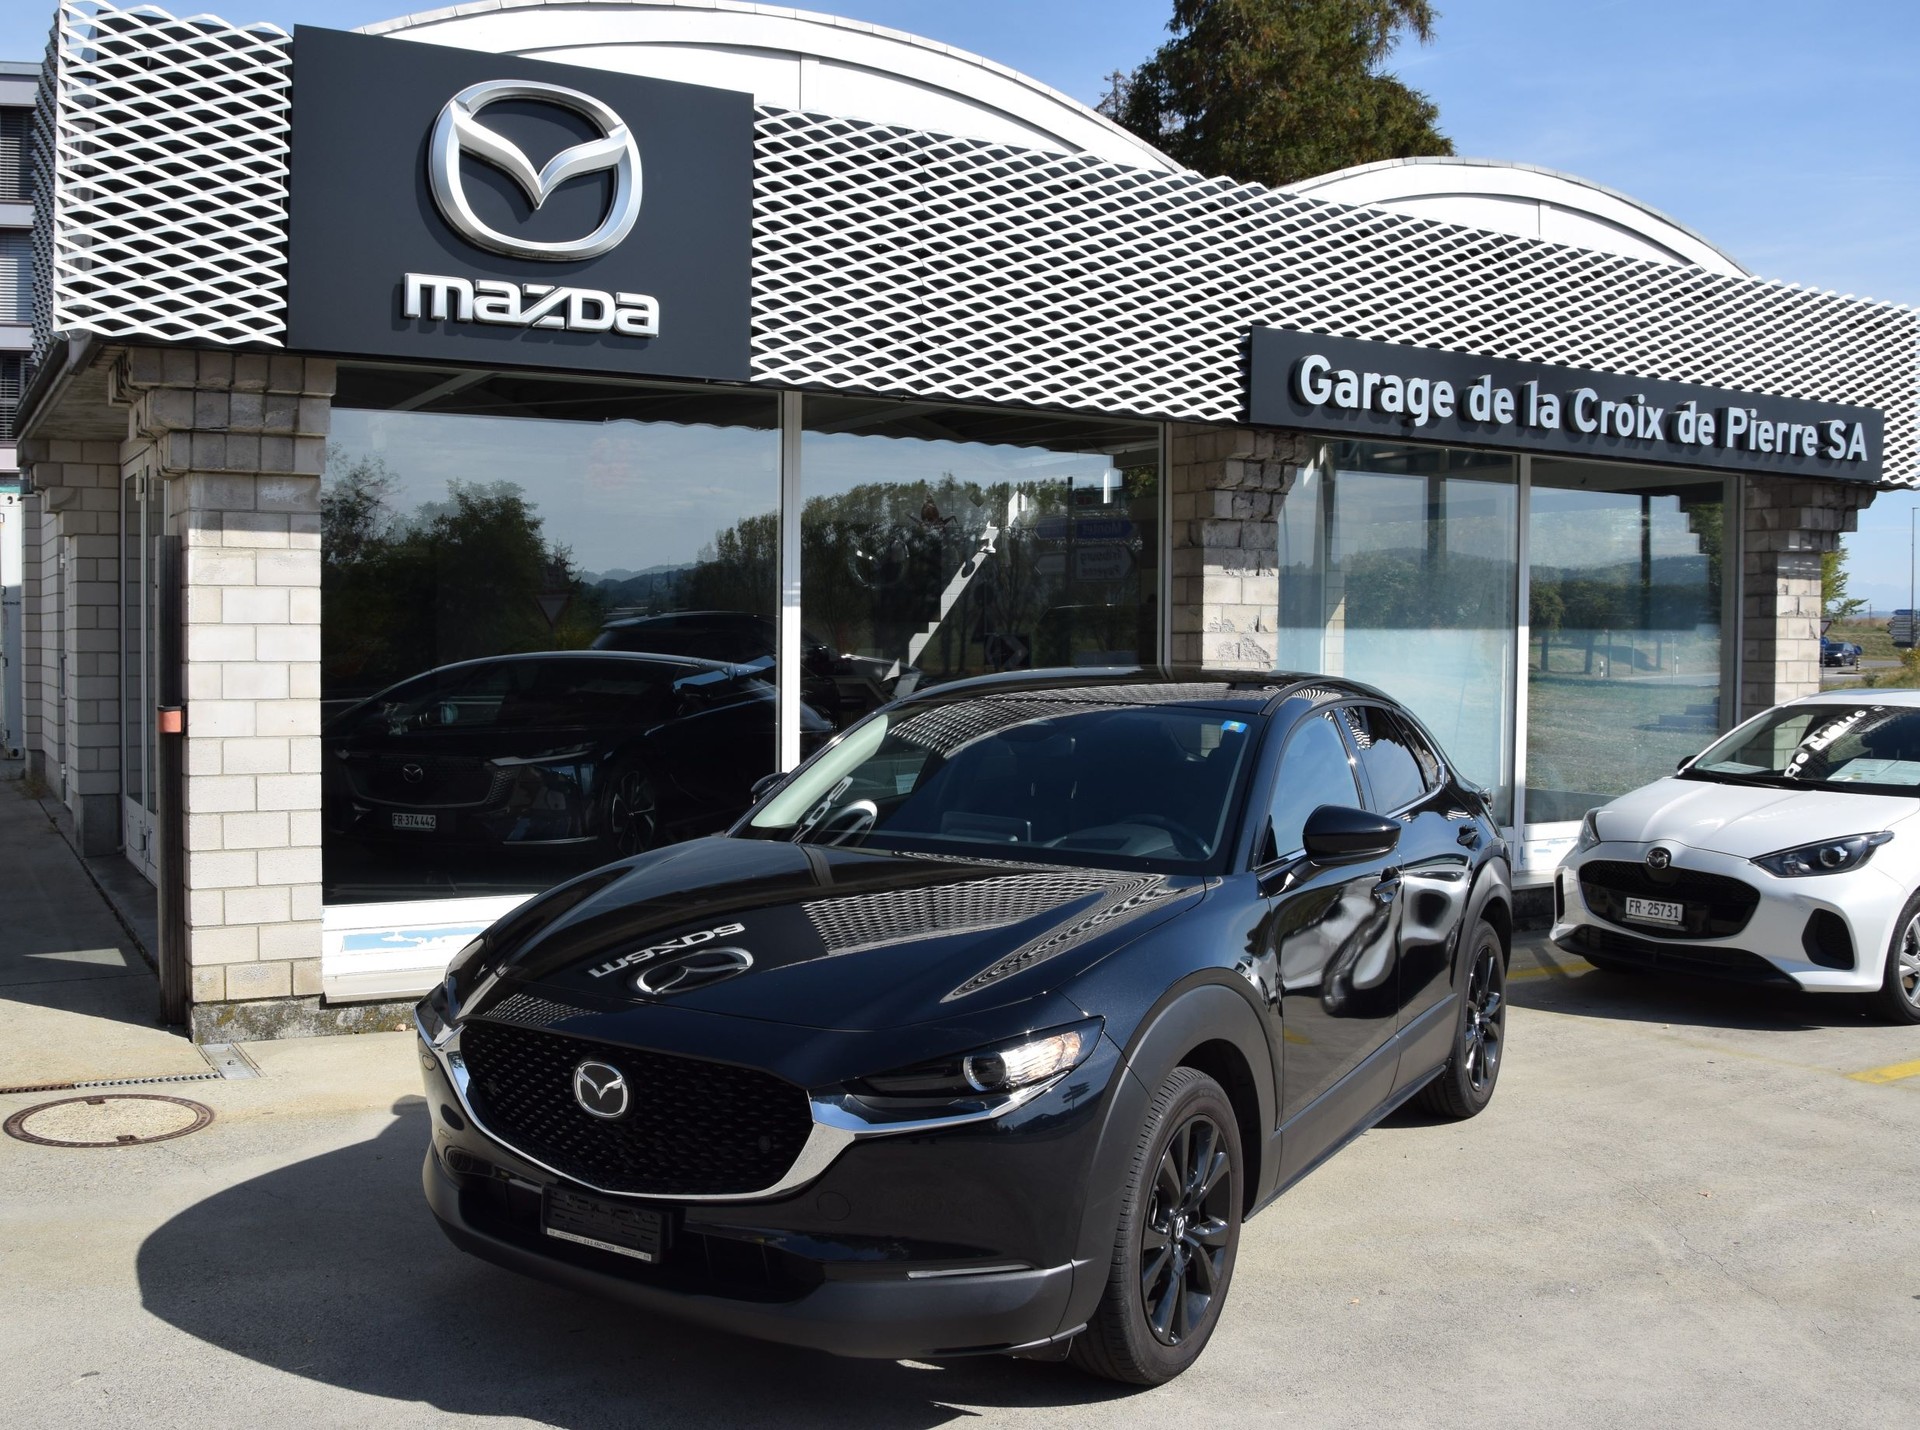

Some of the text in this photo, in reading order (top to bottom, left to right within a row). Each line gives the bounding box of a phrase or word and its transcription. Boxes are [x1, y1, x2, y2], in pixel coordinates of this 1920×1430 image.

[404, 272, 660, 337] mazda
[1298, 354, 1868, 462] Garage de la Croix de Pierre SA
